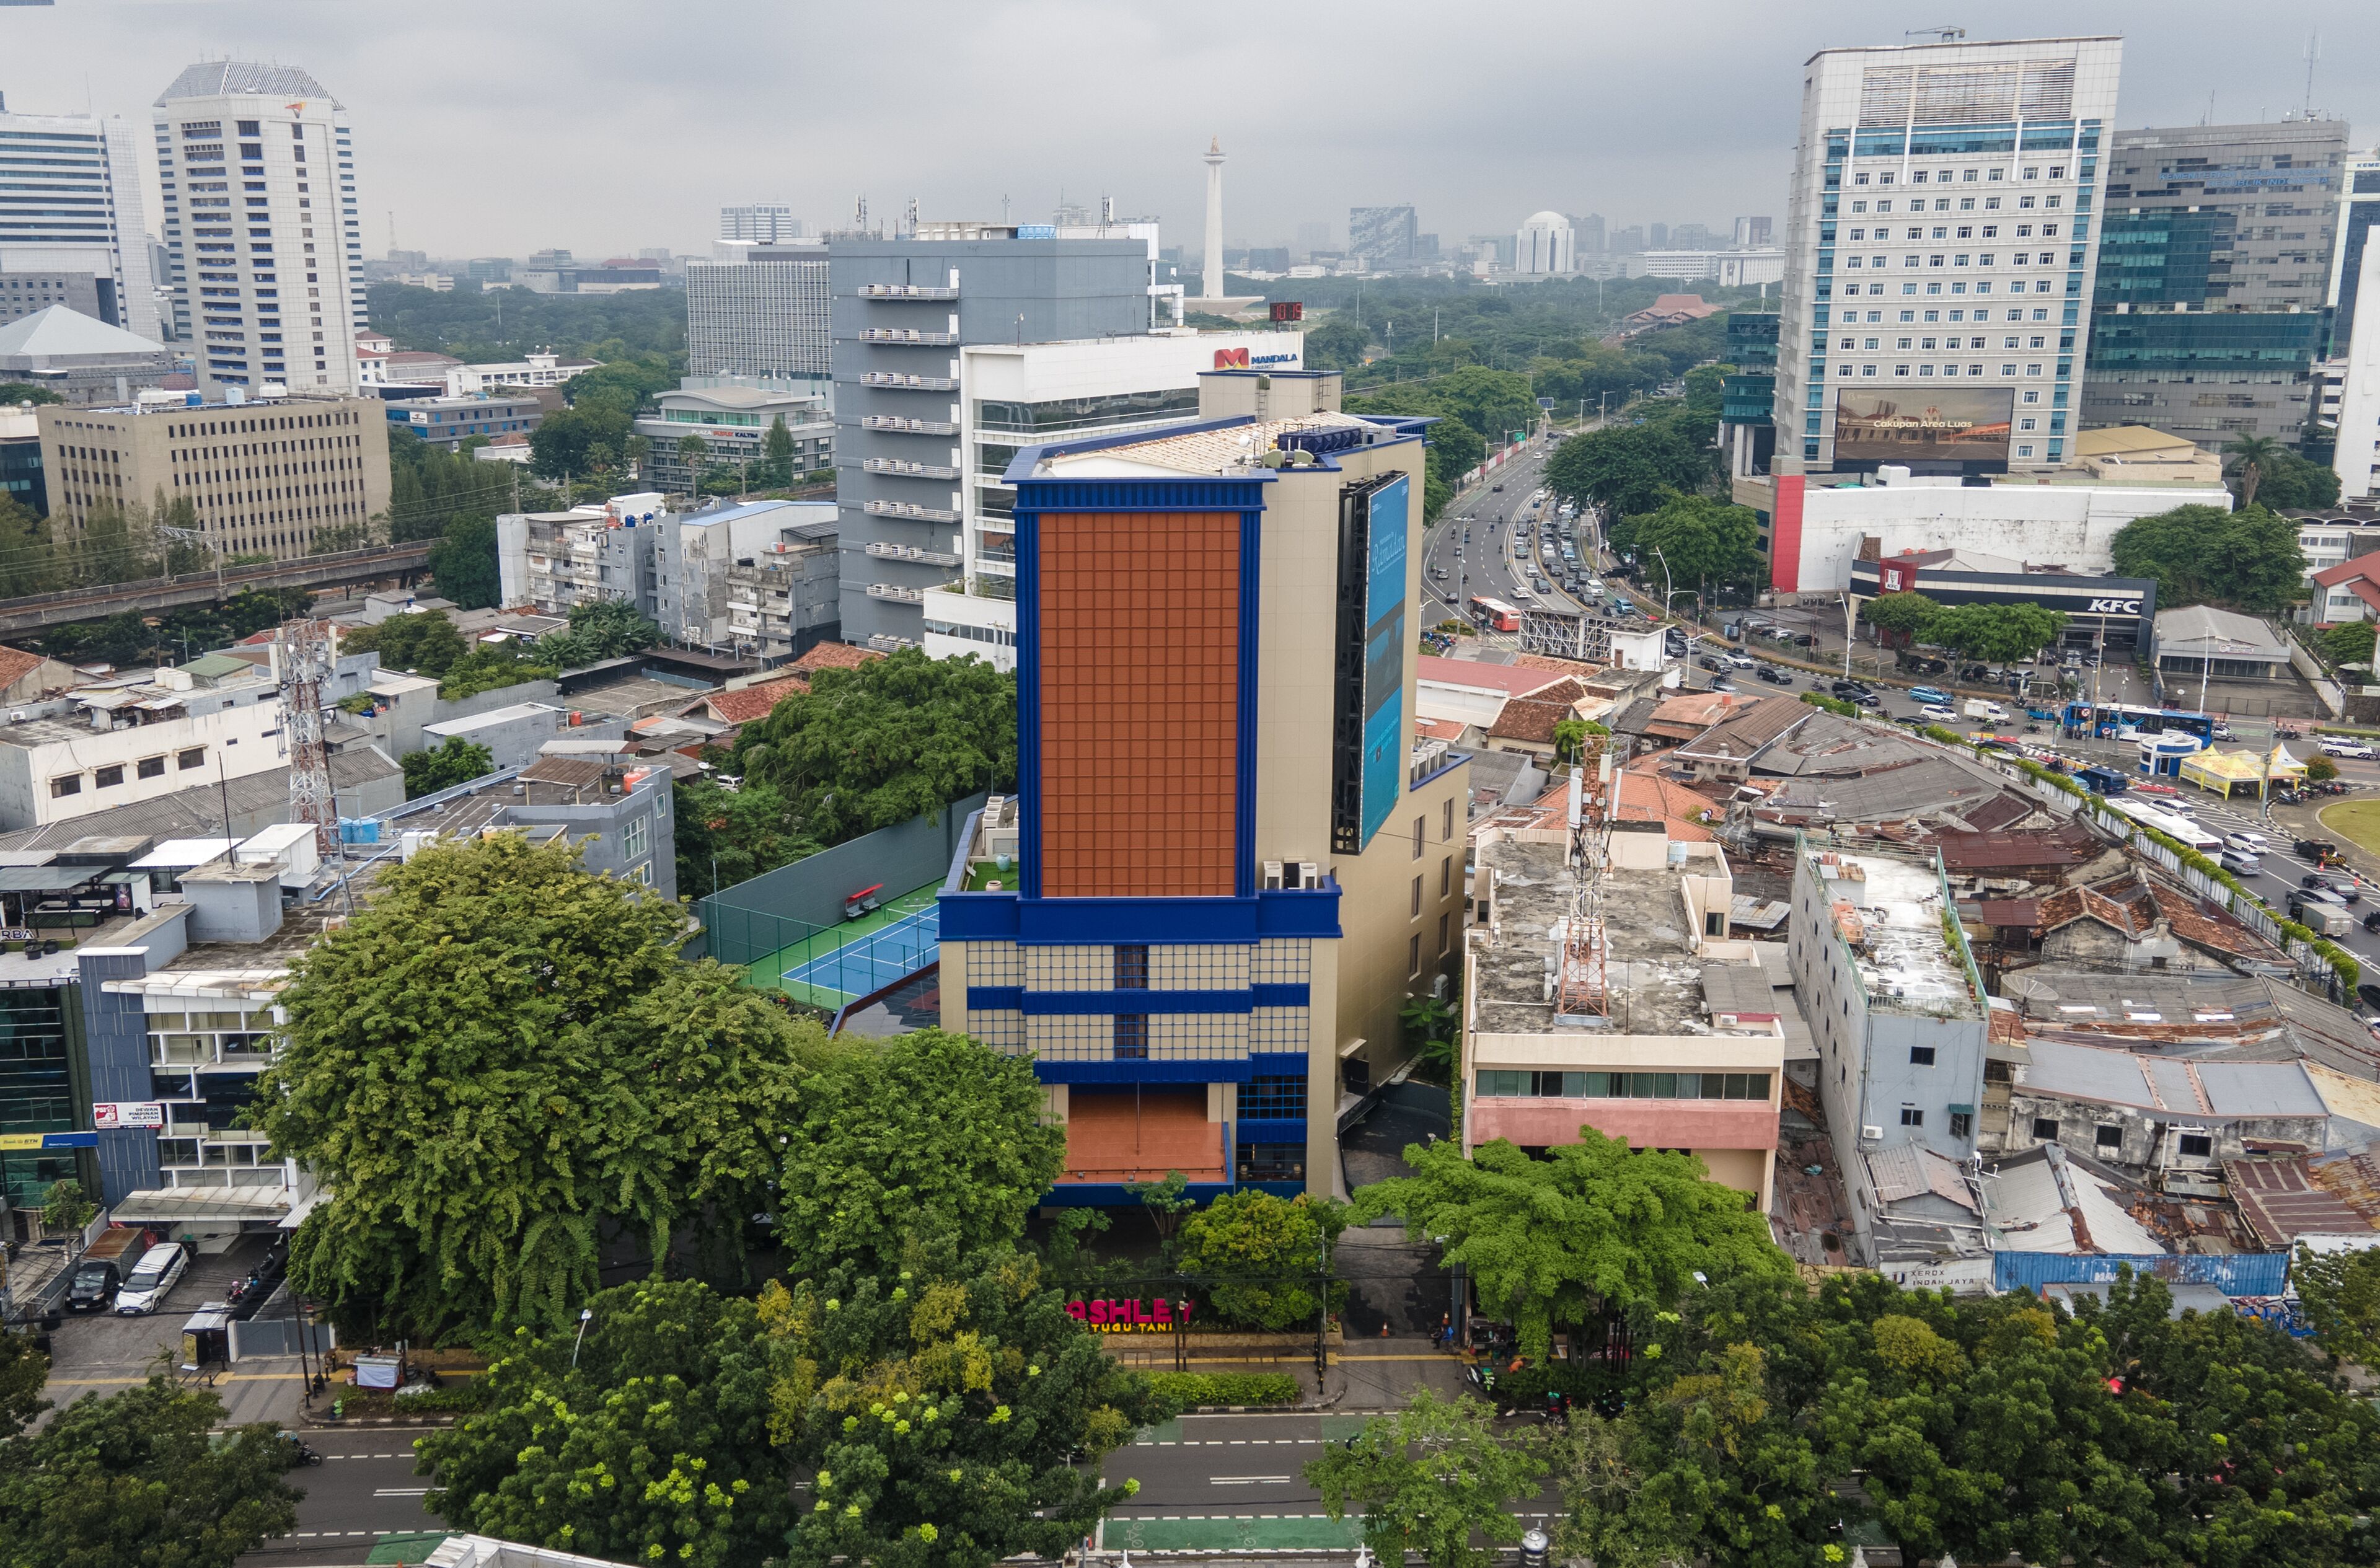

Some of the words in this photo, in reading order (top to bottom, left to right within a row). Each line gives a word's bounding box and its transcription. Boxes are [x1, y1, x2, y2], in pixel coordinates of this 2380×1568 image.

[2267, 177, 2329, 185] INDONESIA
[1251, 353, 1297, 364] MANDALA
[1874, 420, 1918, 429] Cakupan
[2087, 599, 2140, 614] KFC
[1065, 1298, 1195, 1324] ASHLEY
[1091, 1323, 1132, 1332] TUGU
[1139, 1323, 1173, 1332] TANI
